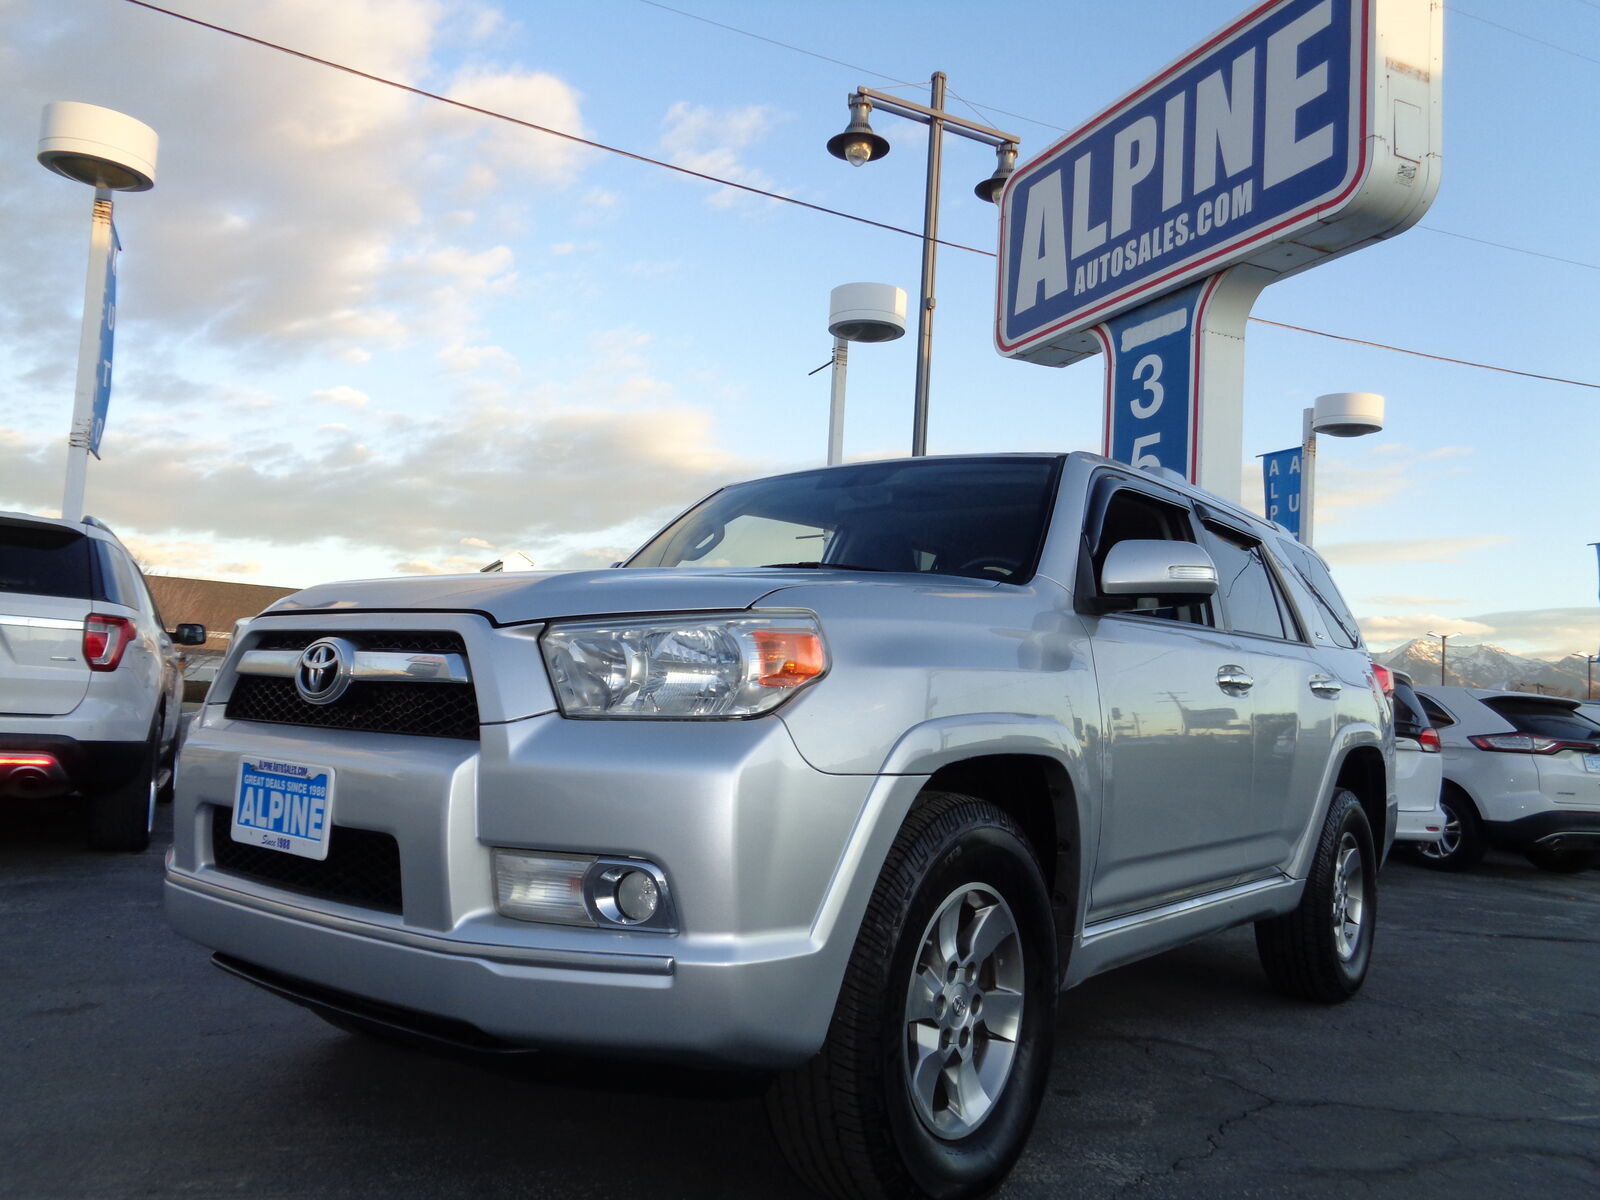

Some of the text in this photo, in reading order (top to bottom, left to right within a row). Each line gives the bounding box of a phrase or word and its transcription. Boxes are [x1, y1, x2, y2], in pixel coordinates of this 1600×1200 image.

[1014, 1, 1334, 316] ALPINE
[1073, 179, 1253, 296] AUTOSALES.COM
[239, 786, 325, 841] ALPINE
[244, 774, 326, 797] GREAT DEALS SINCE 1988
